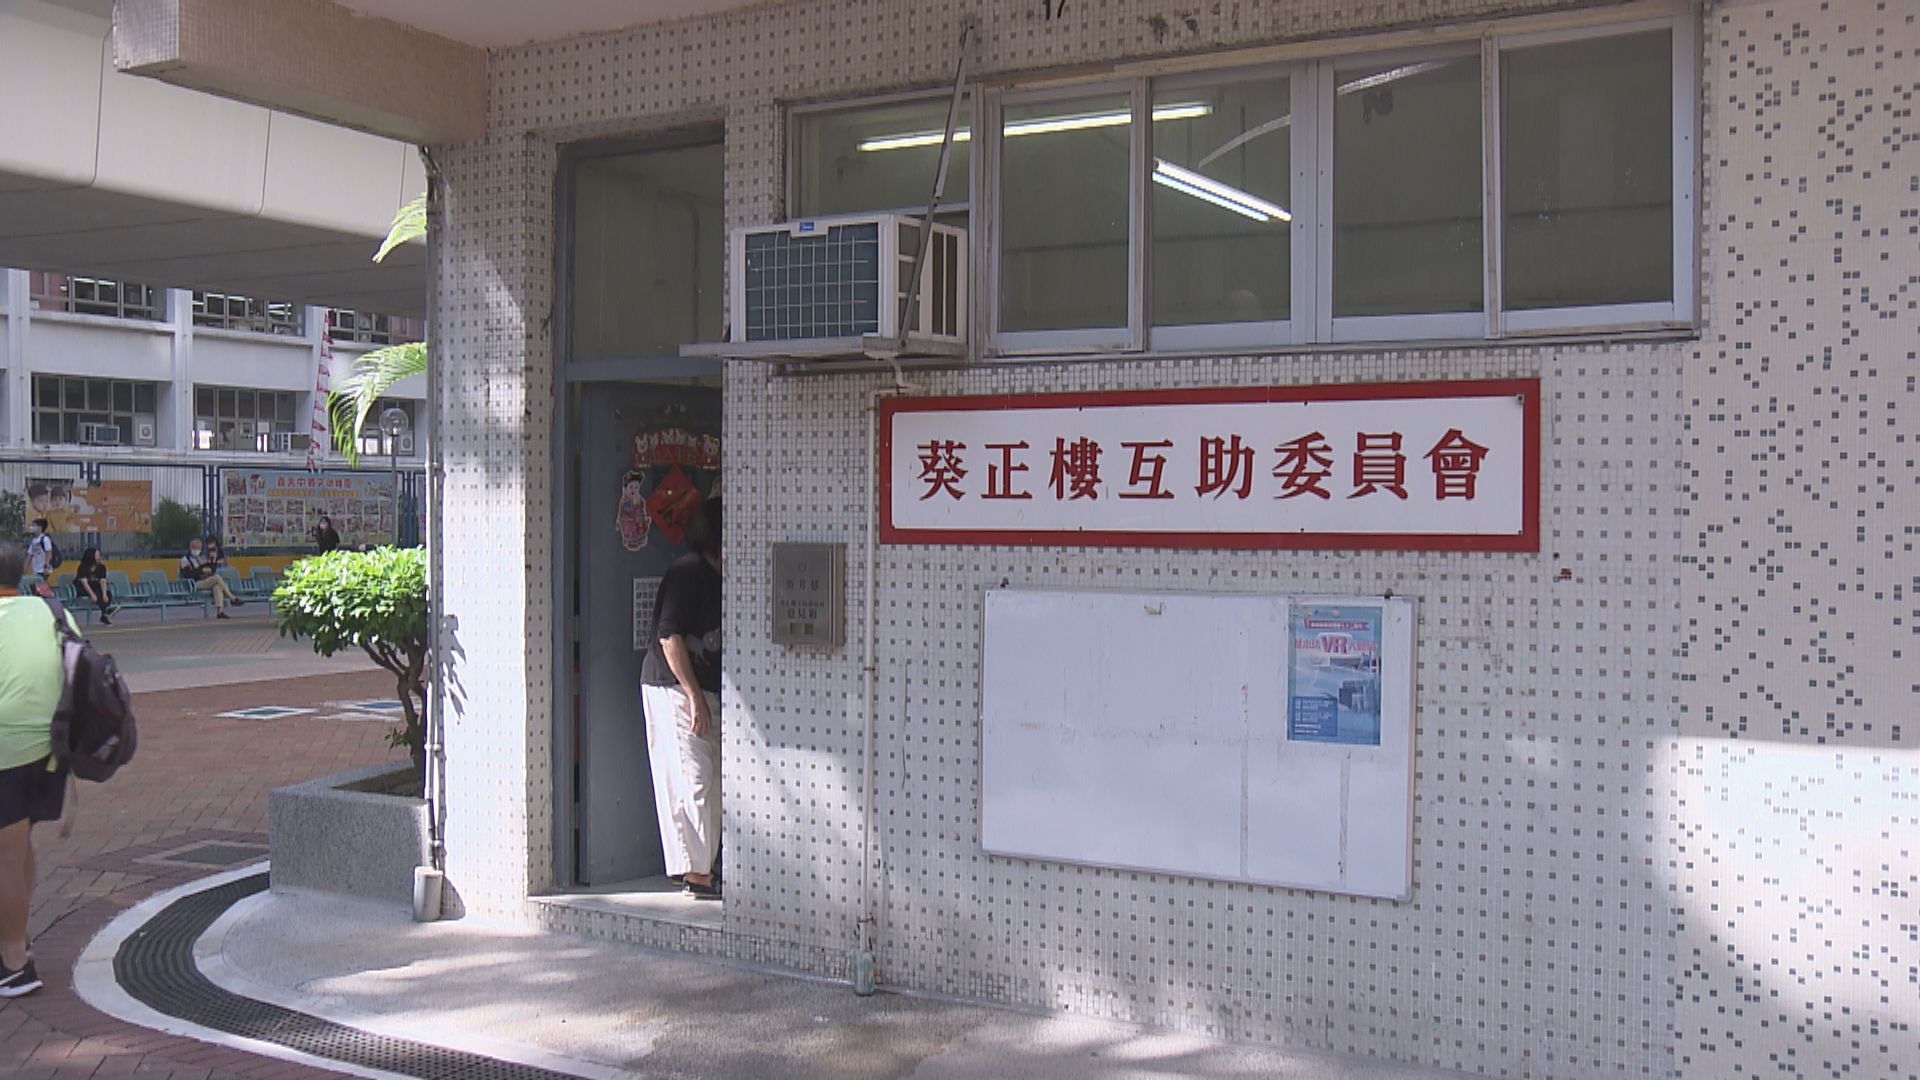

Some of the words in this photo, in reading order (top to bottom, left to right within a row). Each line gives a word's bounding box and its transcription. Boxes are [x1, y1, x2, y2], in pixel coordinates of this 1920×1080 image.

[916, 428, 1491, 501] 葵正樓互助委員會
[1320, 635, 1348, 654] VR
